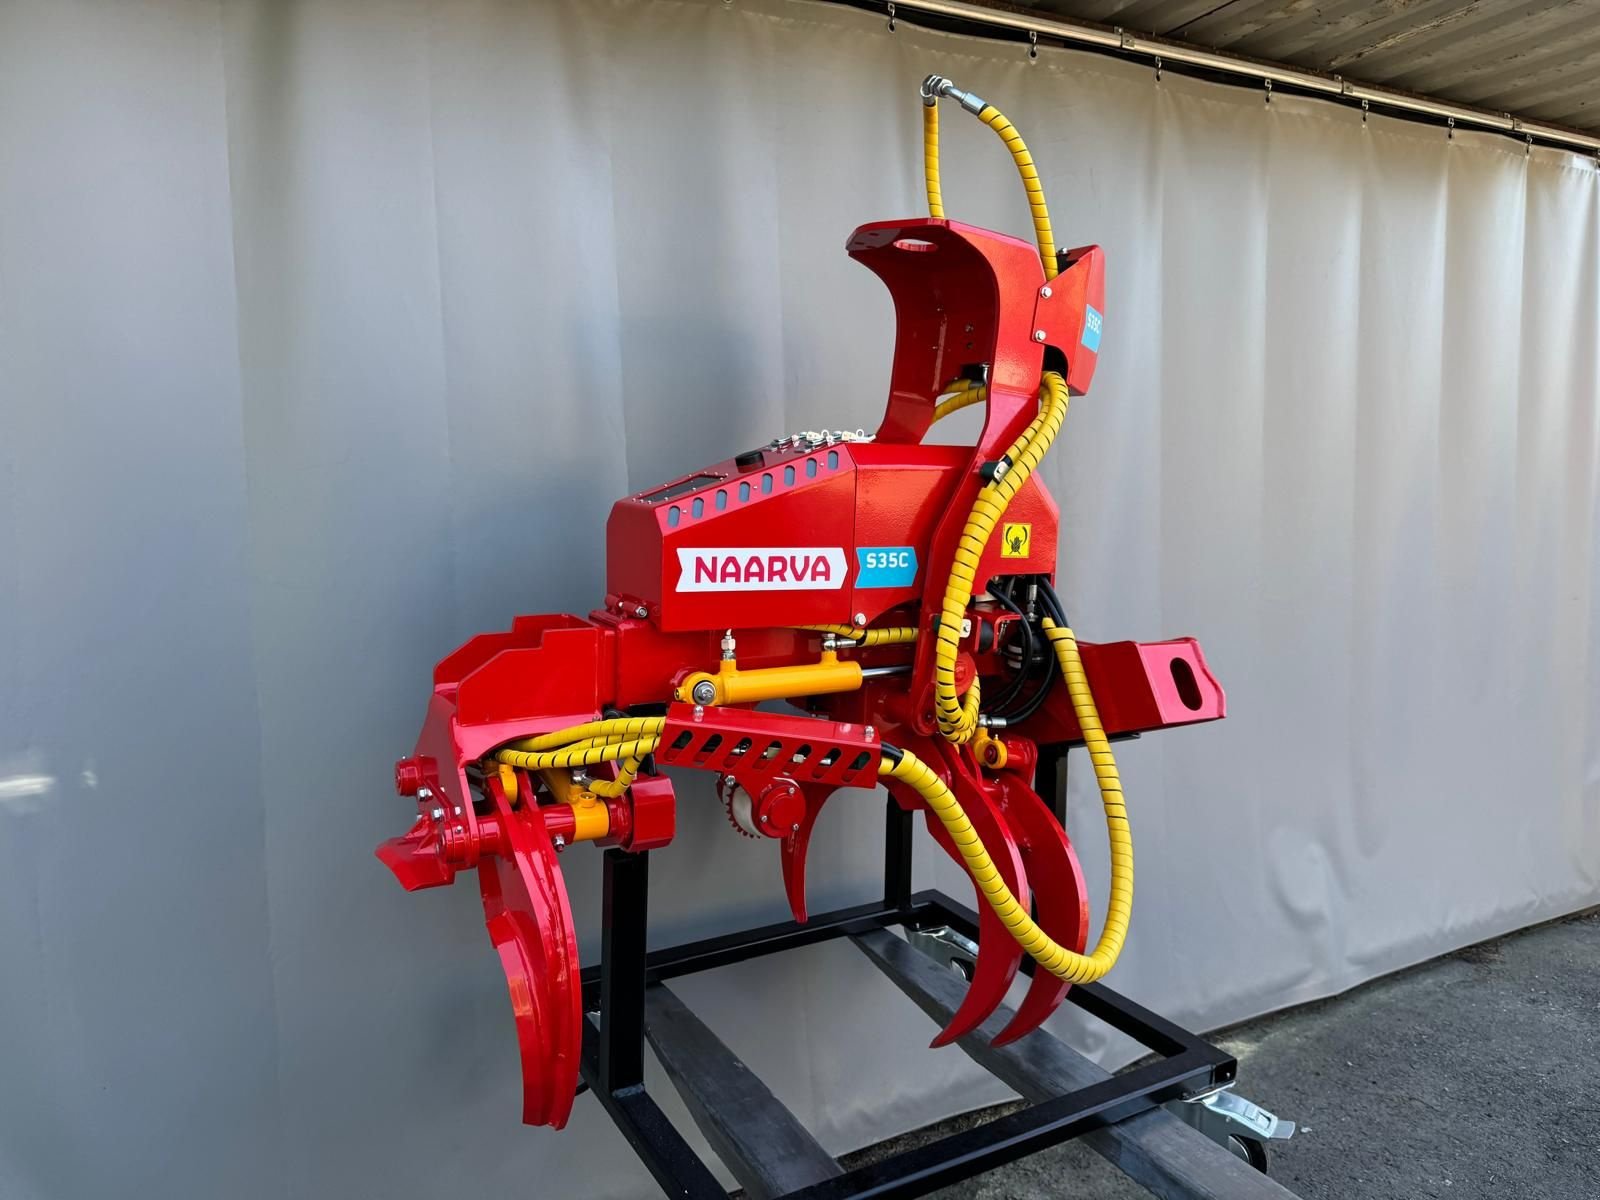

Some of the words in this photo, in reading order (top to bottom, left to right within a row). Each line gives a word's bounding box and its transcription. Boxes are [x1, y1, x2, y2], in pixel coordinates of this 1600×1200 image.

[1087, 312, 1101, 335] S35C
[695, 555, 831, 583] NAARVA
[866, 552, 909, 569] S35C
